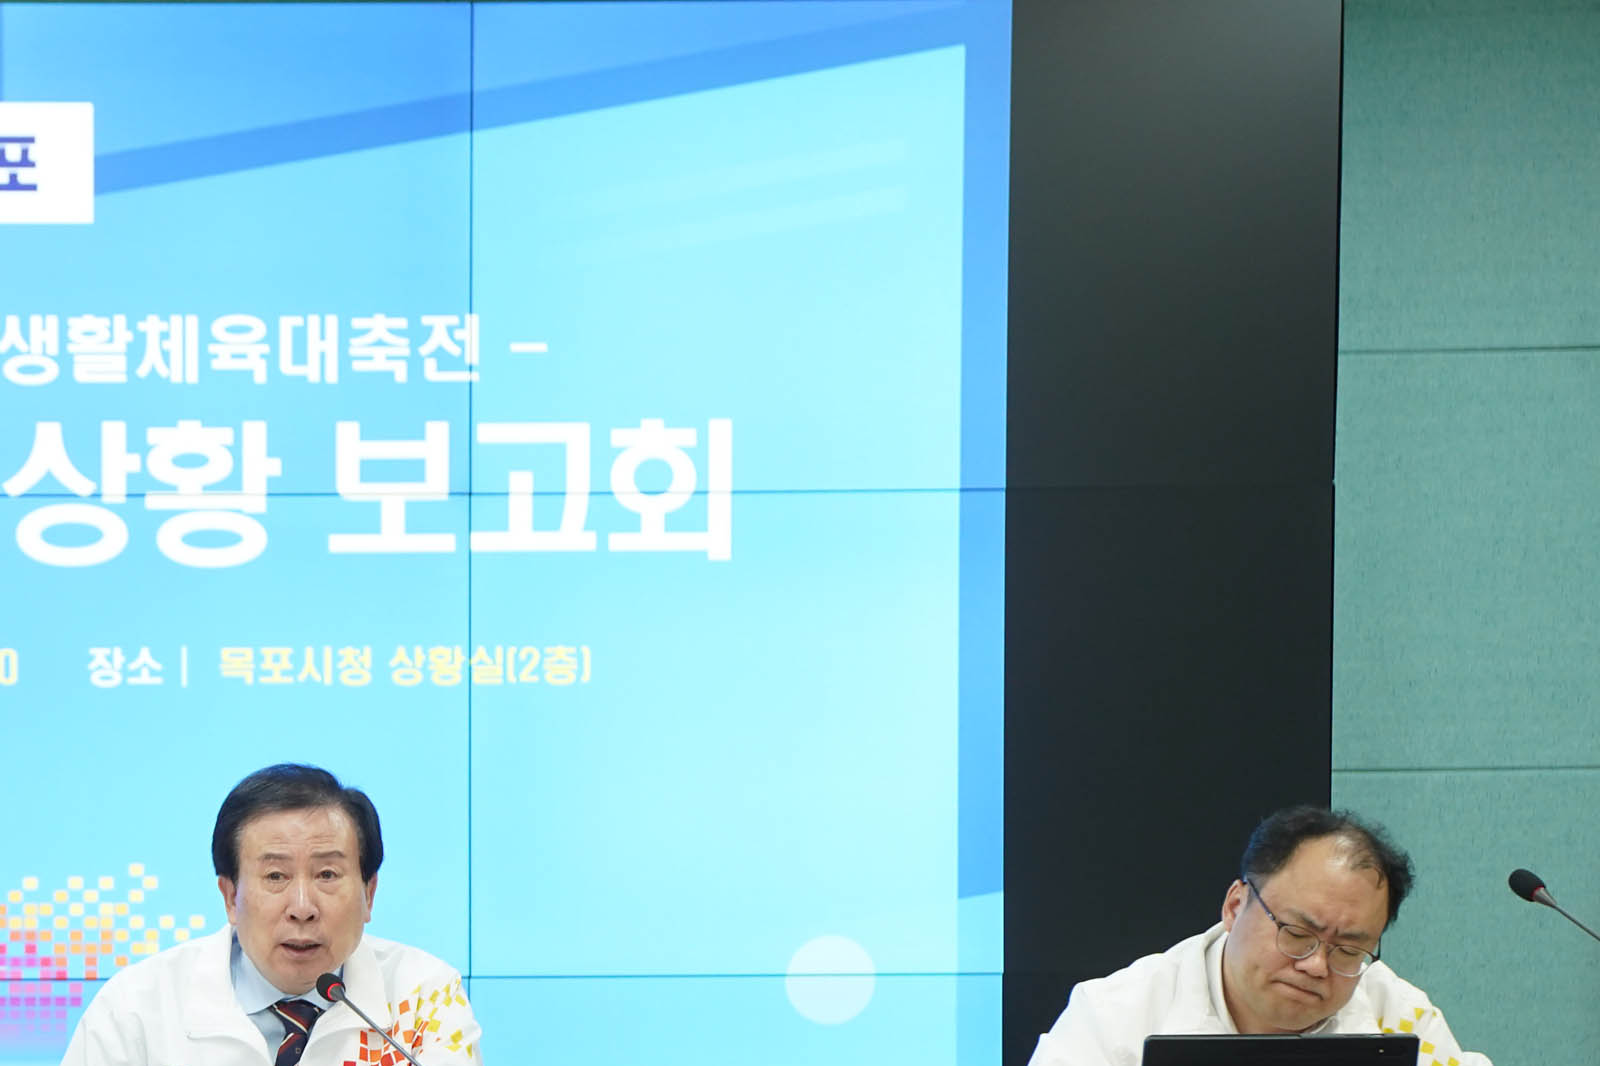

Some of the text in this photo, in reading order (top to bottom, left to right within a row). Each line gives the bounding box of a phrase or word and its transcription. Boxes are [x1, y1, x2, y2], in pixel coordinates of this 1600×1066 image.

[328, 418, 734, 562] 보고회
[88, 647, 164, 689] 장소
[220, 646, 372, 687] 목포시청
[390, 645, 592, 687] 상황실(2층)
